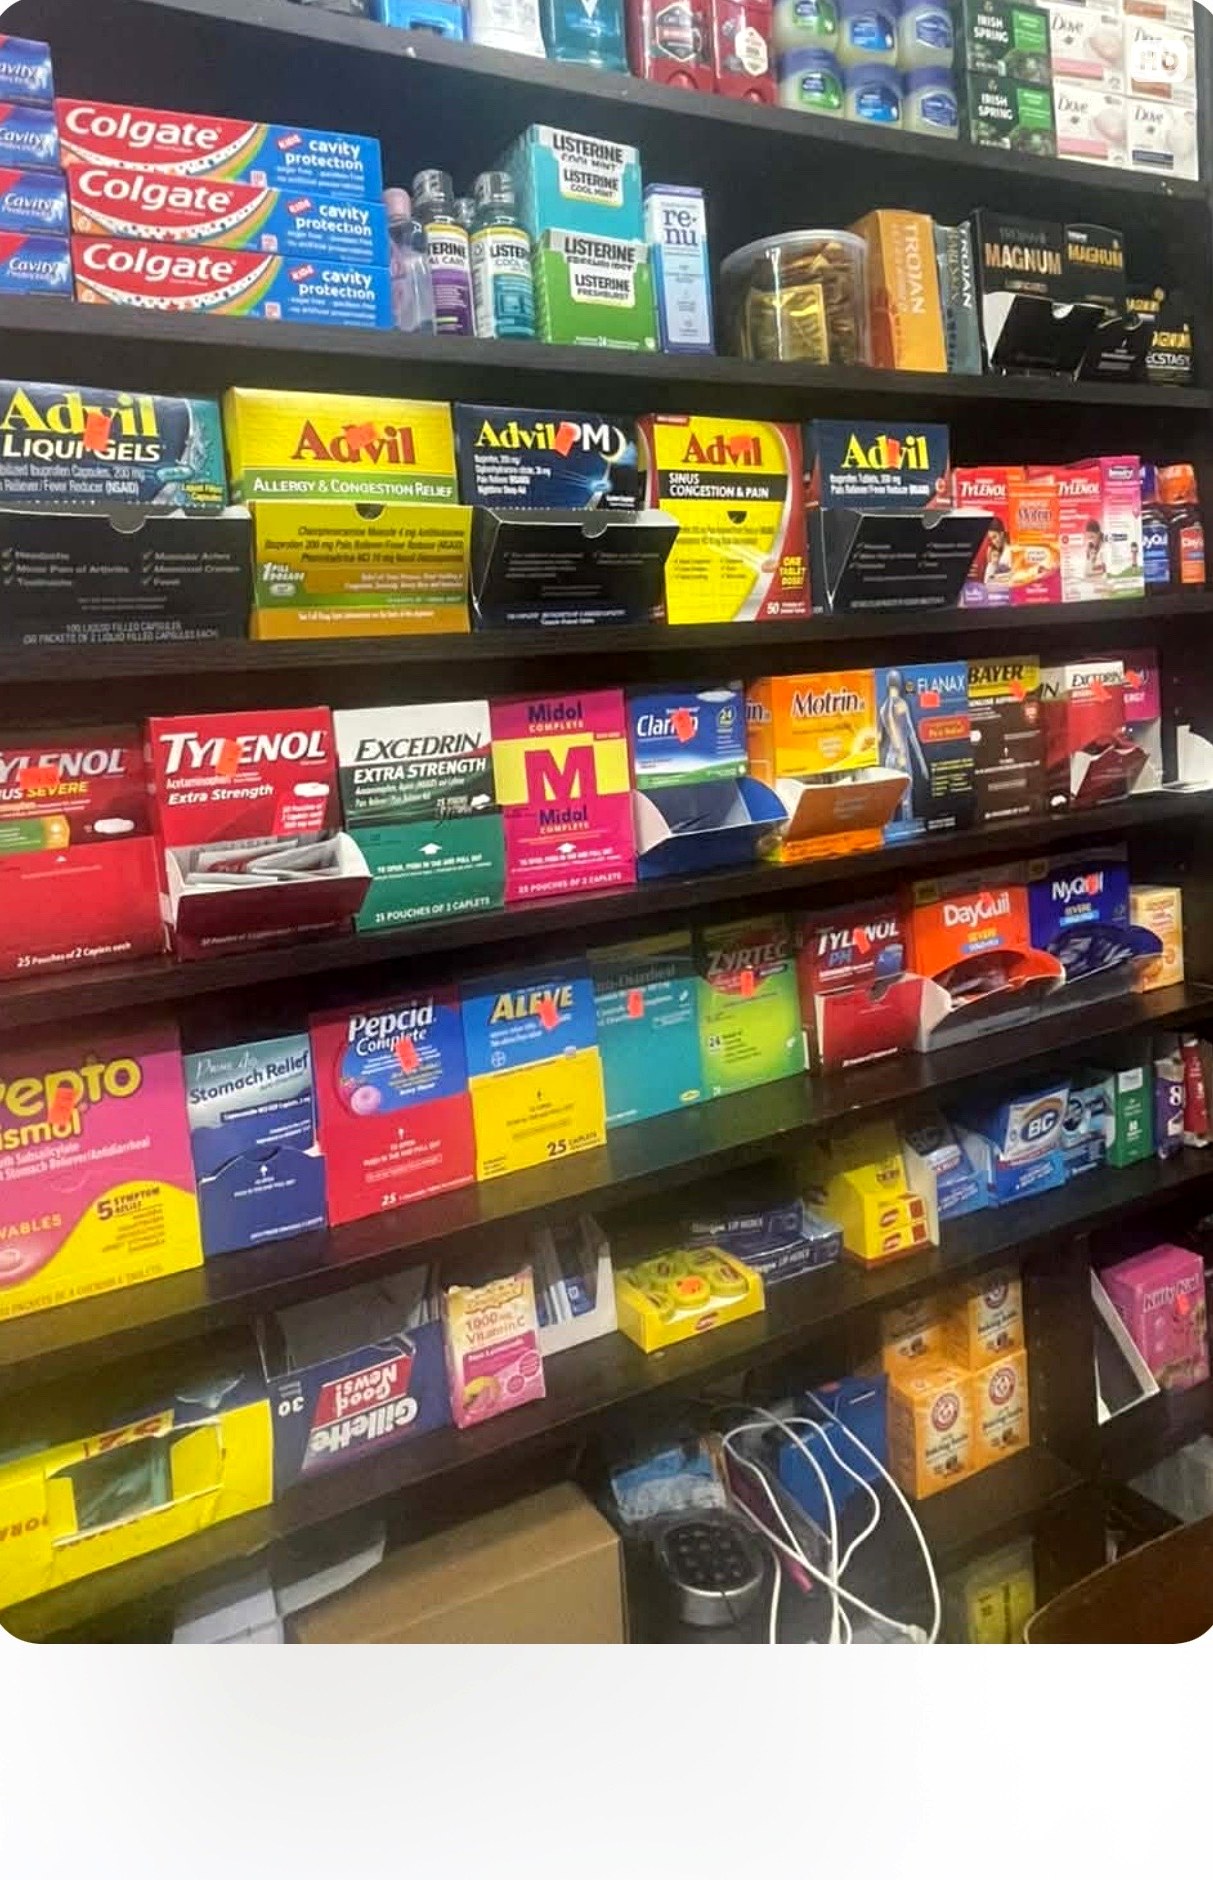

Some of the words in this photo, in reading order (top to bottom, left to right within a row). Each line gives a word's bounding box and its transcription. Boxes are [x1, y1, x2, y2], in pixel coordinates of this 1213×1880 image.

[978, 14, 1003, 29] IRISH
[1052, 16, 1083, 33] Dove
[974, 27, 1009, 43] SPRING
[0, 59, 37, 80] avity
[981, 94, 1008, 107] IRISH
[1058, 95, 1088, 113] Dove
[978, 105, 1013, 120] SPRING
[1135, 106, 1163, 122] Dove
[66, 107, 218, 149] Colgate
[309, 139, 360, 157] cavity
[553, 134, 623, 162] LISTERINE
[285, 153, 363, 171] protection
[564, 169, 618, 190] LISTERINE
[79, 169, 232, 213] Colgate
[6, 192, 54, 213] Cavity
[319, 205, 369, 223] cavity
[296, 217, 372, 236] protection
[665, 227, 698, 246] nu
[565, 237, 635, 262] LISTERINE
[985, 243, 1062, 275] MAGNUM
[1068, 243, 1123, 268] MAGNUM
[9, 257, 59, 276] Cavity
[83, 241, 234, 283] Colgate
[905, 224, 926, 313] TROJAN
[322, 270, 372, 288] cavity
[575, 274, 629, 291] LISTERINE
[299, 284, 375, 300] protection
[292, 420, 416, 465] Advil
[475, 420, 556, 450] Advil
[4, 434, 160, 462] LIQUIGELS
[254, 477, 315, 492] ALLERGY
[318, 480, 328, 492] &
[331, 479, 414, 496] CONGESTION
[415, 483, 452, 497] RELIEF
[669, 473, 700, 485] SINUS
[961, 482, 1005, 497] TYLENOL
[1058, 481, 1100, 496] TYLENOL
[669, 484, 736, 497] CONGESTION
[737, 487, 745, 498] &
[746, 487, 769, 499] PAIN
[768, 603, 779, 615] 50
[968, 665, 1023, 684] BAYER
[528, 701, 583, 722] Midol
[793, 689, 859, 716] Motrin
[529, 720, 584, 733] COMPLETE
[159, 730, 325, 775] TYLENOL
[355, 731, 481, 762] EXCEDRIN
[353, 766, 404, 784] EXTRA
[406, 758, 487, 778] STRENGTH
[524, 746, 597, 800] M
[27, 781, 89, 798] SEVERE
[168, 791, 210, 806] Extra
[211, 784, 274, 802] Strength
[539, 804, 588, 824] Midol
[539, 822, 589, 834] COMPLETE
[1052, 872, 1104, 902] NyQl
[387, 907, 430, 921] POUCHES
[431, 905, 444, 915] OF
[453, 896, 490, 911] CAPLETS
[943, 892, 1010, 928] DayQuil
[817, 922, 899, 956] TYLNOL
[17, 956, 31, 968] 25
[75, 947, 83, 958] 2
[709, 940, 787, 973] ZYRTEC
[490, 985, 573, 1024] ALEVE
[349, 997, 434, 1042] Pepcid
[356, 1028, 427, 1056] Compete
[0, 1058, 142, 1117] epto
[190, 1069, 263, 1105] Stomach
[266, 1051, 309, 1080] Relief
[1169, 1085, 1182, 1106] 8
[1027, 1112, 1056, 1140] BC
[547, 1139, 567, 1157] 25
[97, 1200, 114, 1221] 5
[382, 1194, 397, 1206] 25
[466, 1311, 497, 1331] 1000
[466, 1322, 515, 1344] Vitamin
[516, 1316, 526, 1328] C
[335, 1364, 397, 1394] News!
[278, 1397, 304, 1417] 30
[336, 1383, 392, 1417] Good
[308, 1397, 418, 1453] Gillette
